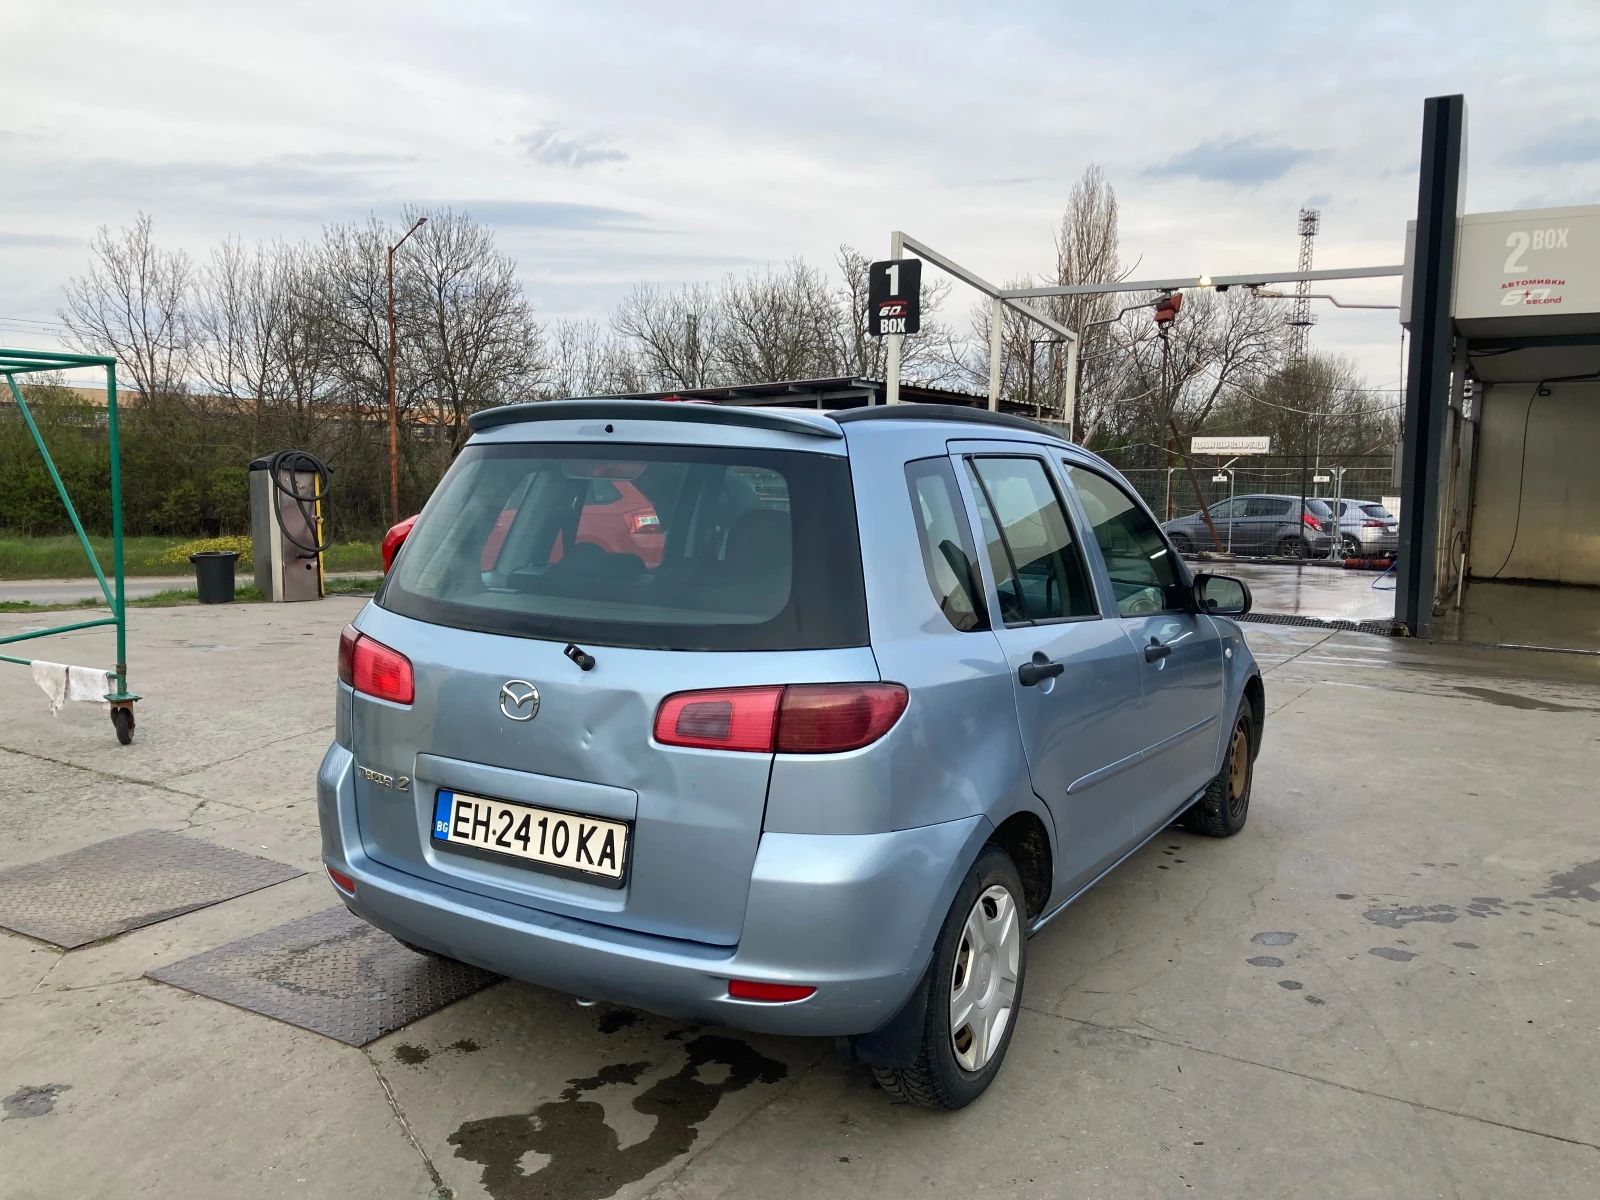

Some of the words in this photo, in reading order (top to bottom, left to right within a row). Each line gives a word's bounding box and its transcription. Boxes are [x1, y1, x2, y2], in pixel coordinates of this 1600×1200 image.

[1503, 231, 1531, 274] 2
[1532, 228, 1570, 250] BOX
[885, 264, 899, 296] 1
[1501, 279, 1566, 289] АВТОМИВКИ
[1525, 296, 1562, 305] second
[879, 305, 902, 316] 60
[880, 317, 906, 333] BOX
[436, 821, 449, 833] BG
